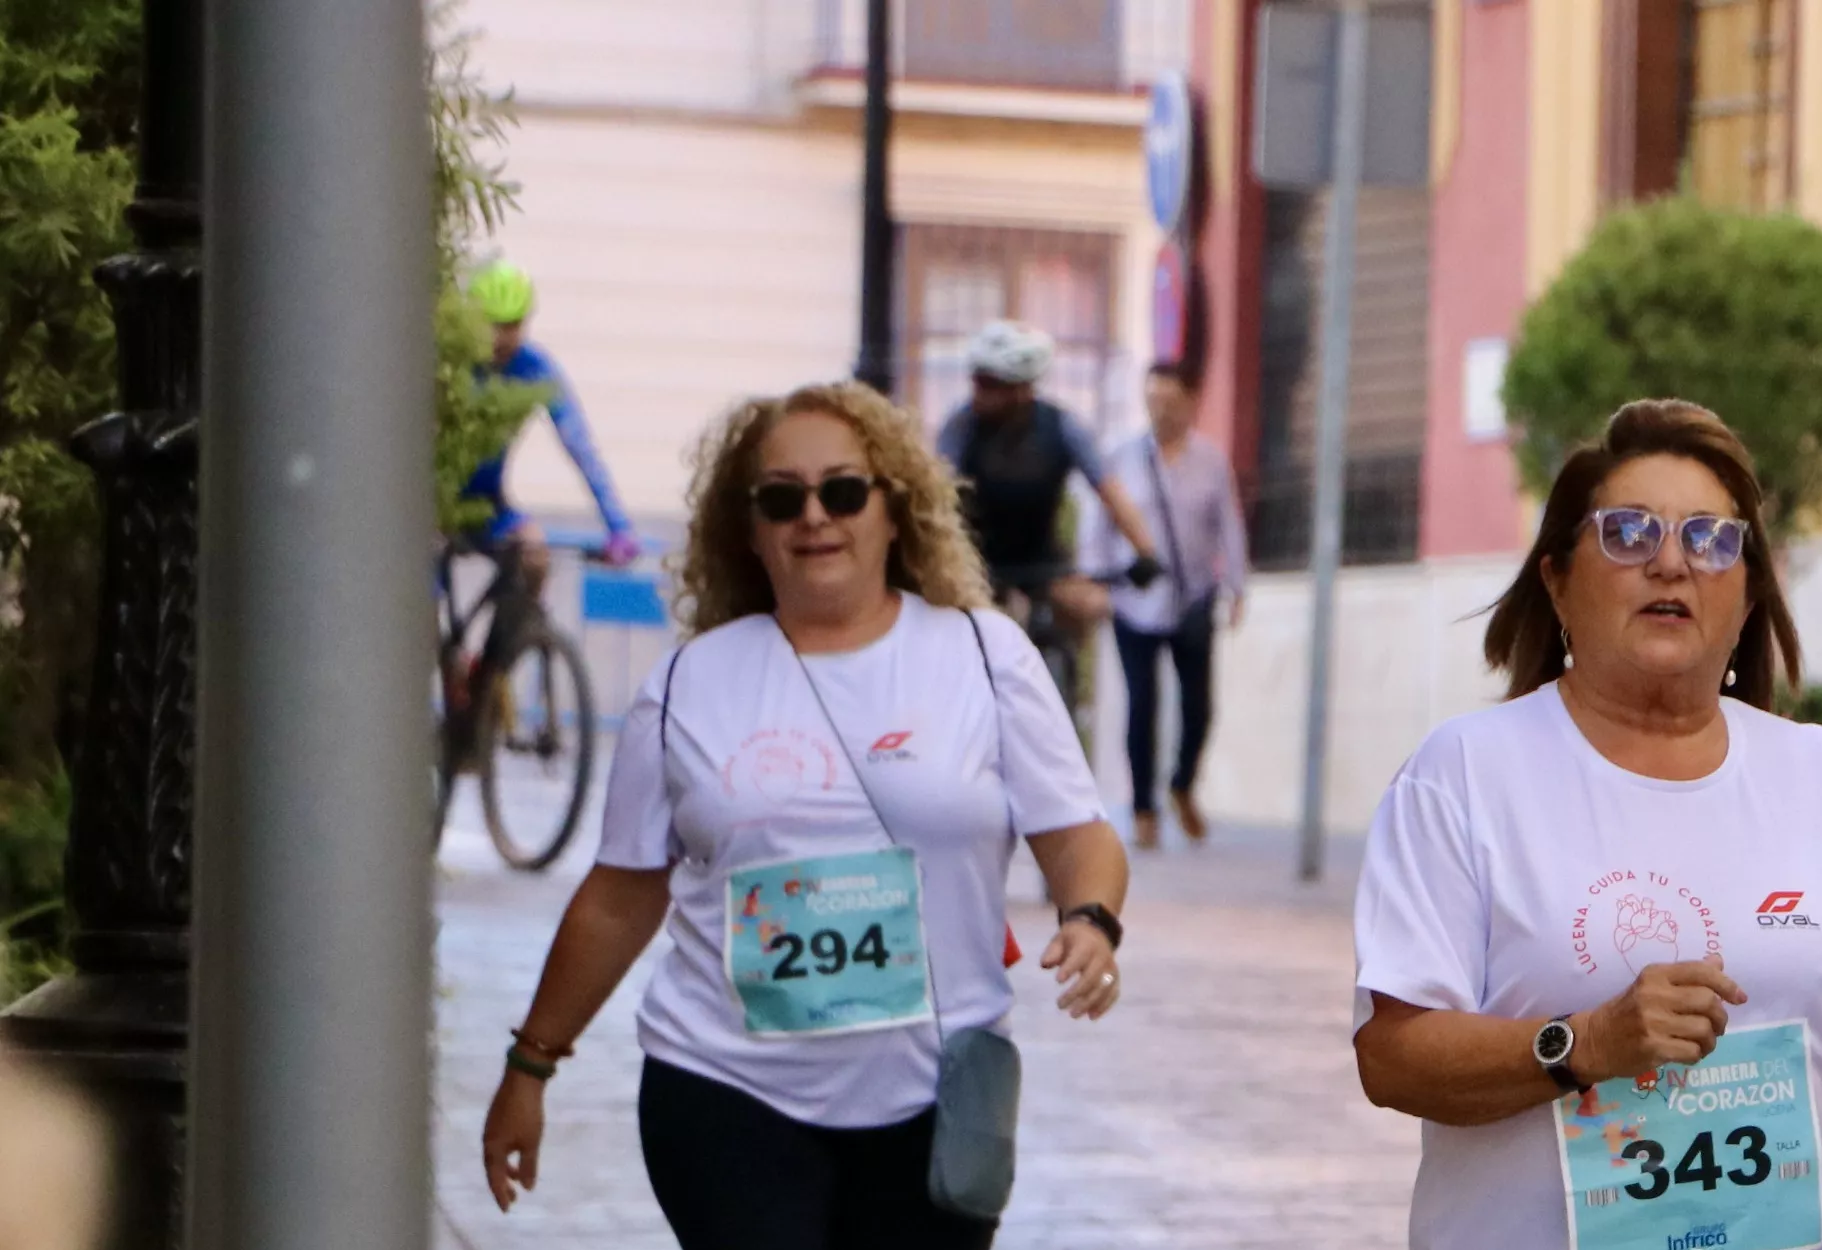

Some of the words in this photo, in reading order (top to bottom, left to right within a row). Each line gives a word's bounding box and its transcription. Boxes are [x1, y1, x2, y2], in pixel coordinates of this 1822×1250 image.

[1589, 870, 1636, 895] CUIDA
[1649, 871, 1669, 886] TU
[769, 923, 890, 982] 294
[1666, 1068, 1689, 1089] IV
[1687, 1061, 1760, 1088] CARRERA
[1621, 1125, 1772, 1200] 343
